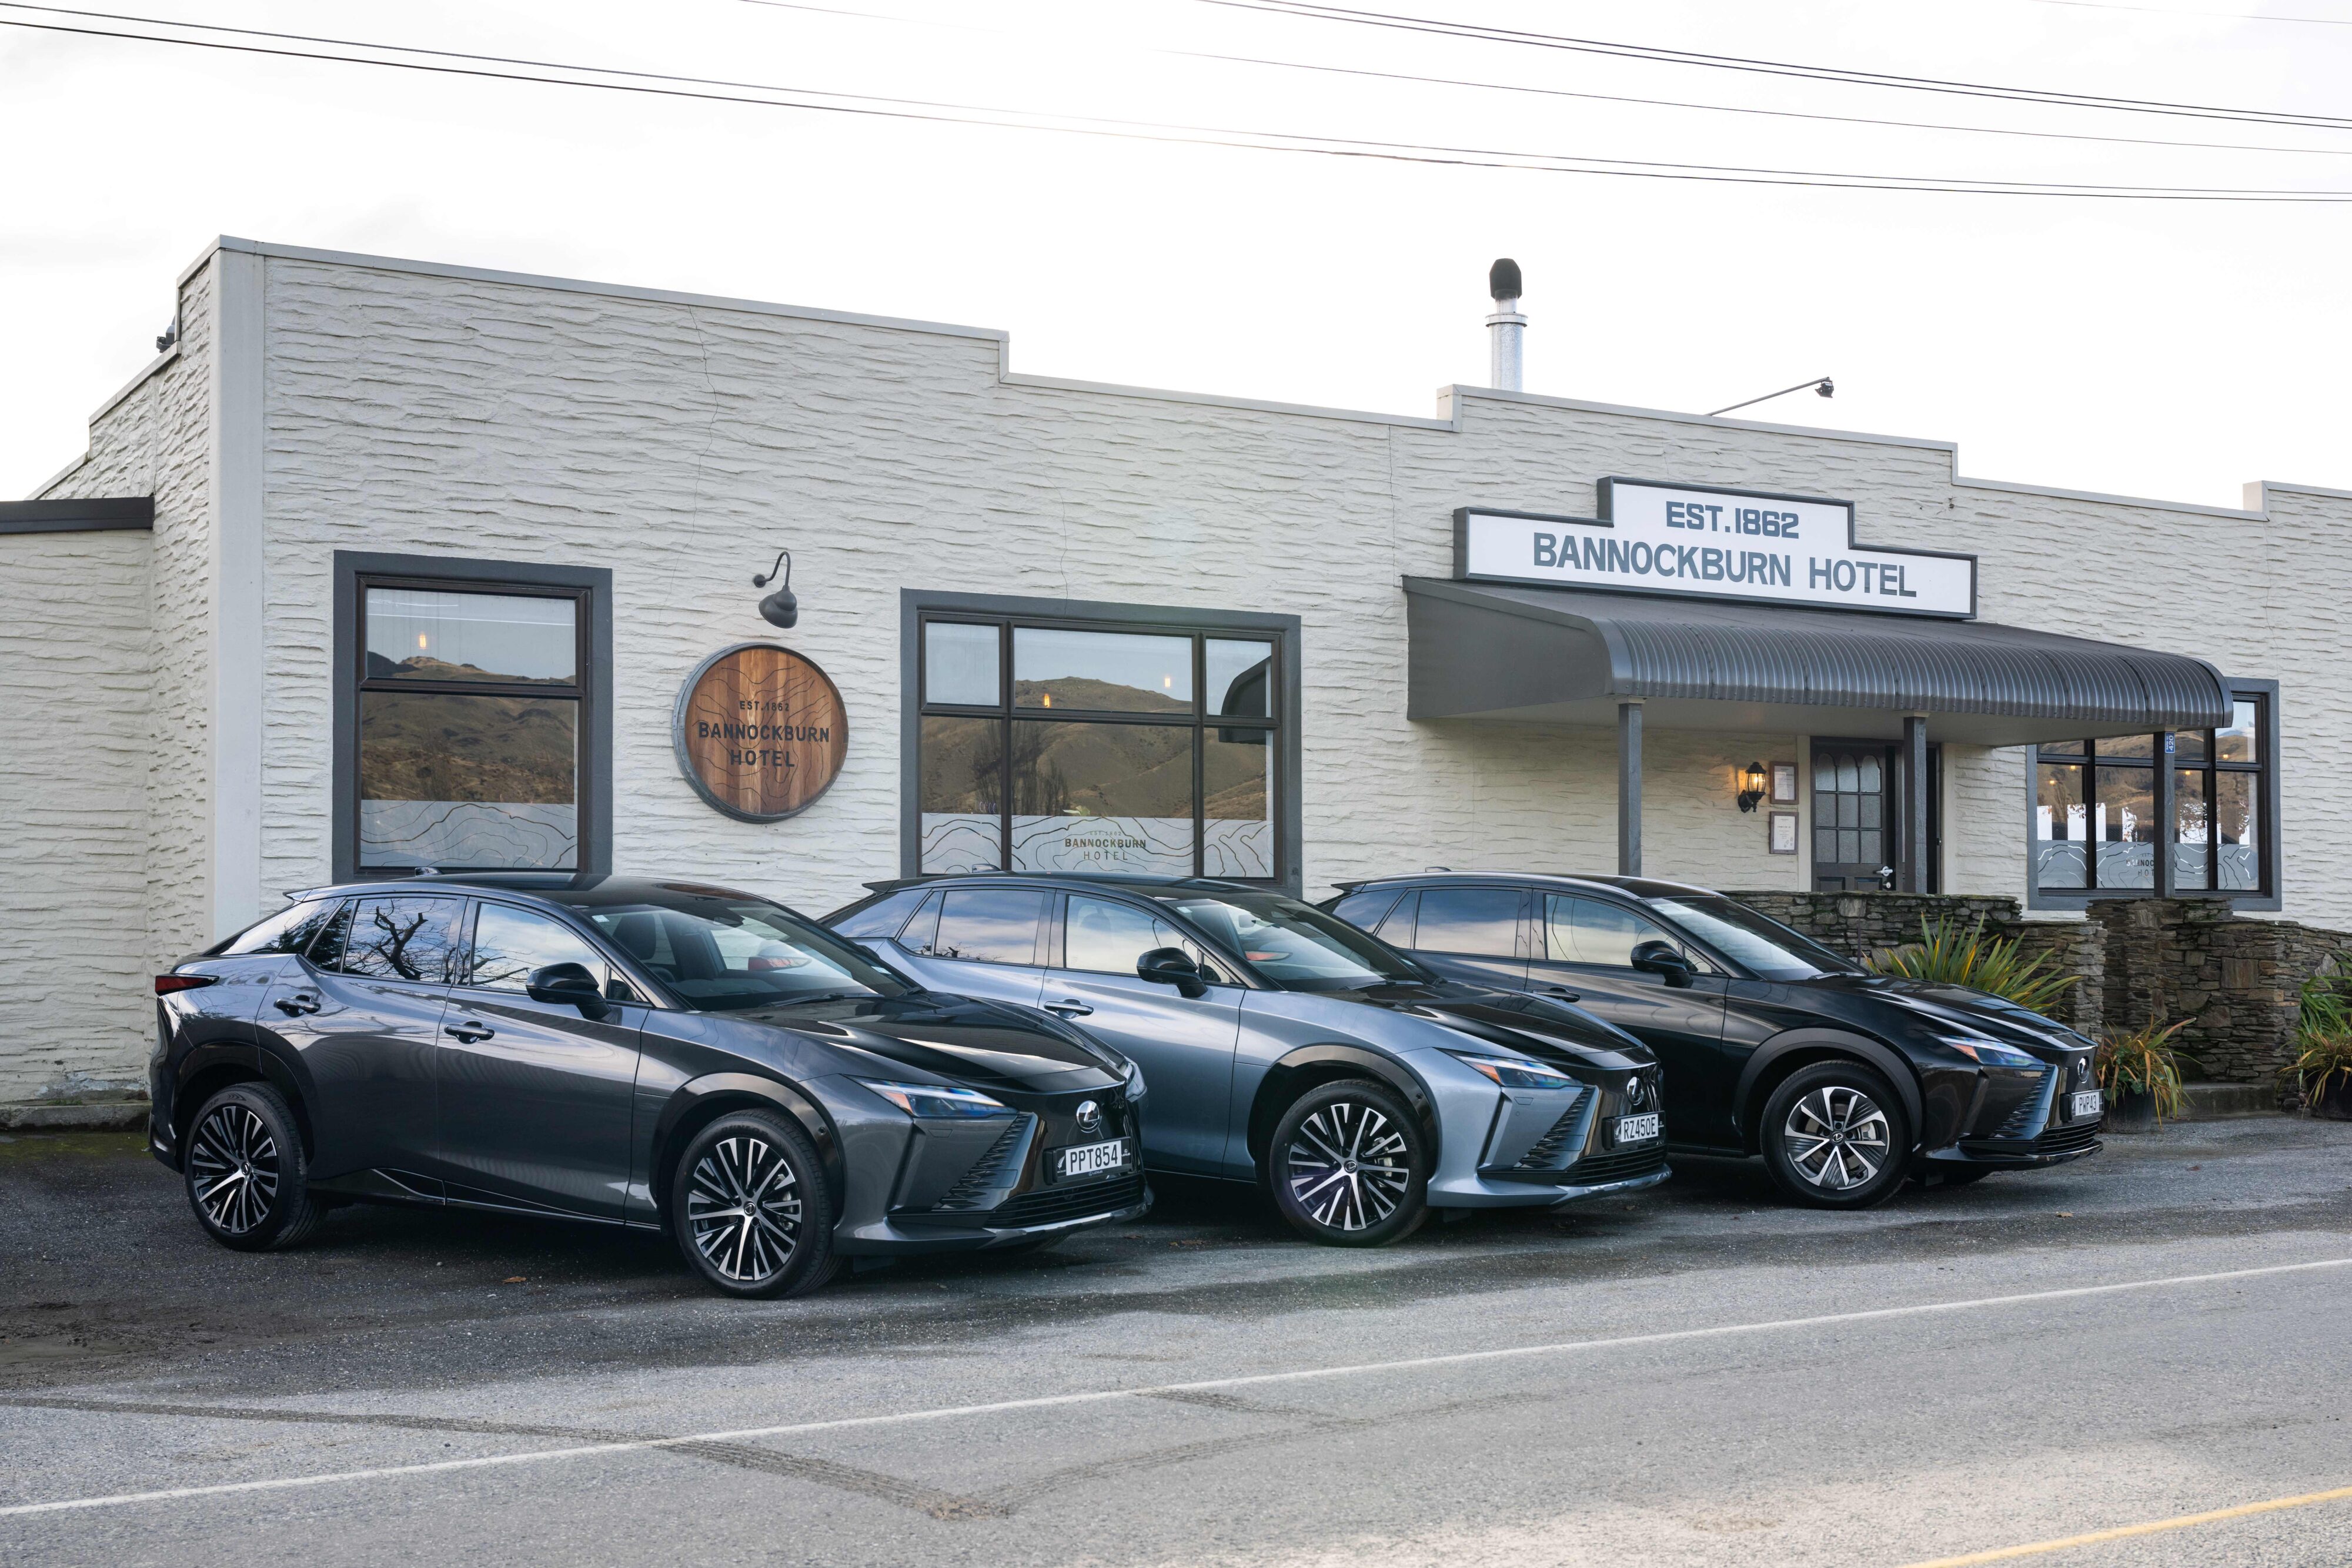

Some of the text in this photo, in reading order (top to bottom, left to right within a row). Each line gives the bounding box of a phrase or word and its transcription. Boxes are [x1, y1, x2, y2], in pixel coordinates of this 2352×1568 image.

[1666, 501, 1799, 539] EST.1862
[1534, 532, 1917, 598] BANNOCKBURN HOTEL
[740, 700, 789, 711] EST.1862
[699, 721, 830, 743] BANNOCKBURN
[730, 749, 795, 767] HOTEL
[1065, 838, 1146, 848] BANNOCKBURN
[1084, 851, 1128, 860] HOTEL
[2079, 1094, 2097, 1114] PWP43
[1624, 1116, 1656, 1139] RZ450E
[1070, 1144, 1118, 1172] PPT854
